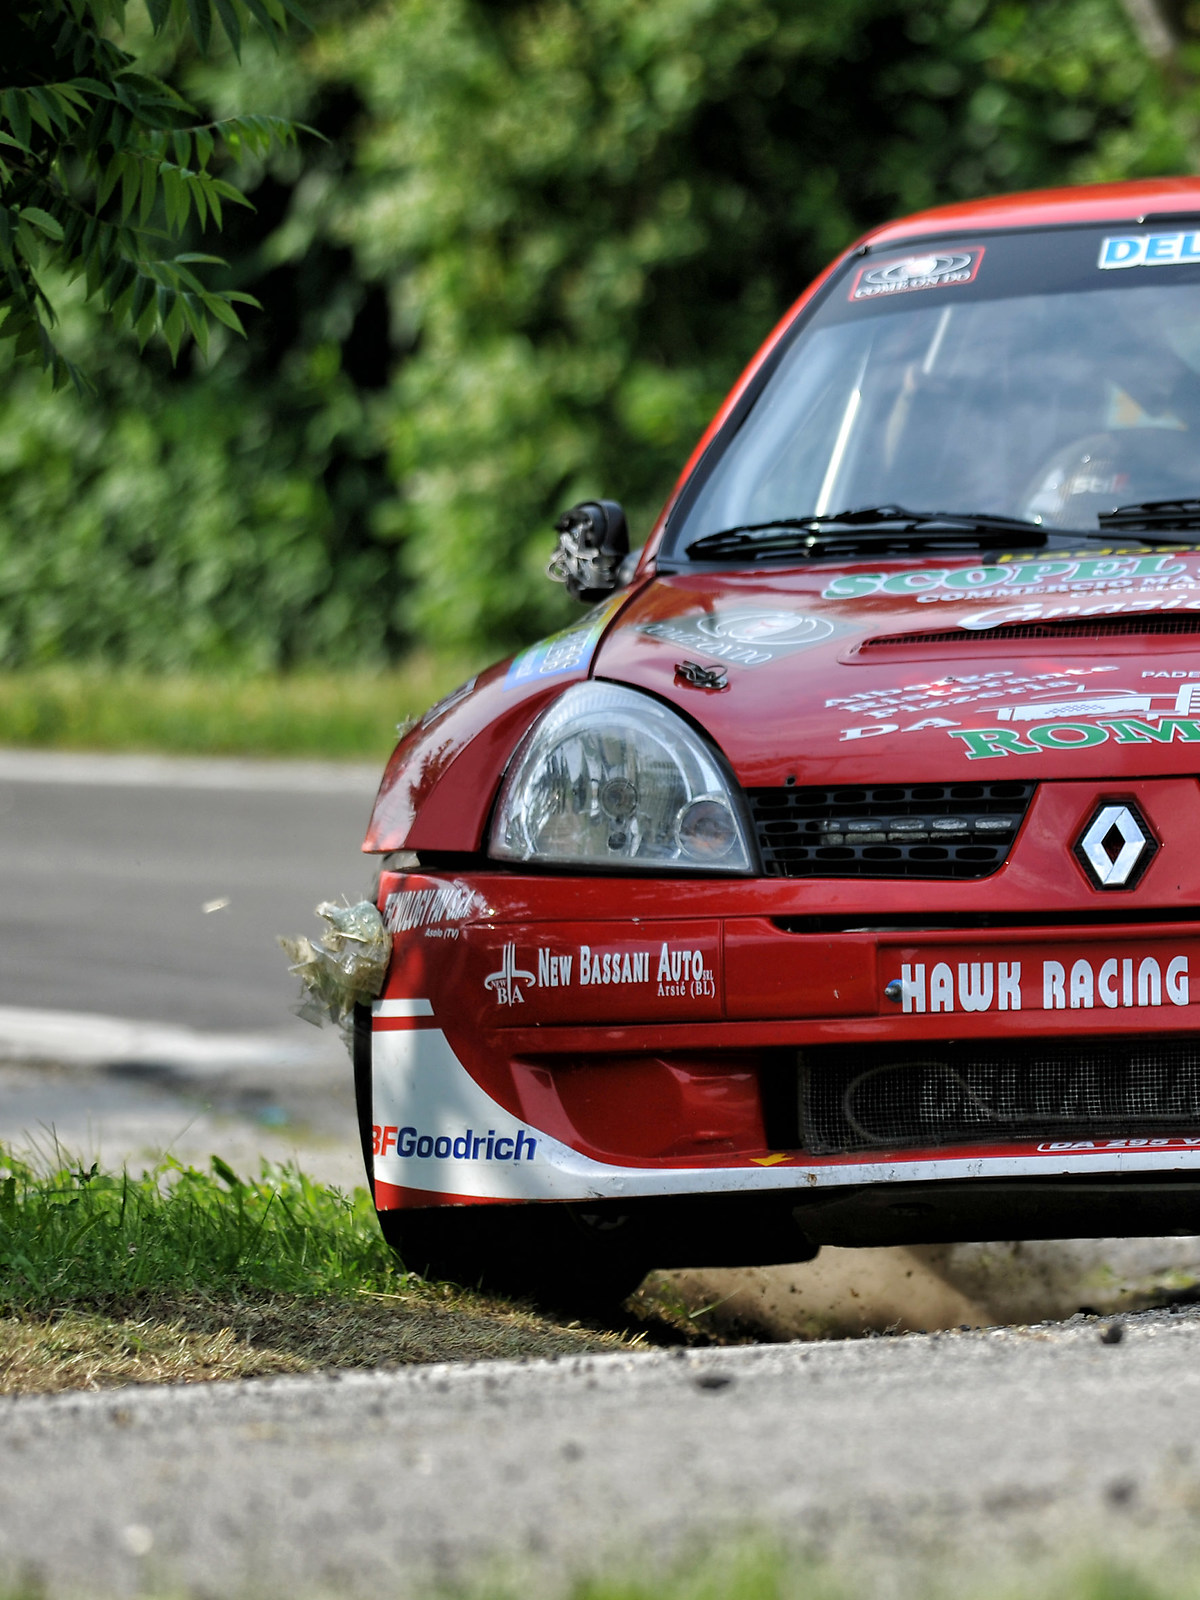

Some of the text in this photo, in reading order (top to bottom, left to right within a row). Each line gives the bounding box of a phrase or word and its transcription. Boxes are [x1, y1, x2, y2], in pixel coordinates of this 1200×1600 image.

[854, 270, 971, 299] COME ON DO
[822, 554, 1187, 600] SCOPEL
[916, 578, 1132, 603] COMMERCIO
[839, 717, 962, 742] DA
[424, 928, 460, 940] Asolo (TV)
[538, 947, 573, 988] NEW
[579, 945, 650, 985] BASSANI
[656, 942, 704, 982] AUTO
[656, 980, 716, 999] Arsié (BL)
[901, 961, 1021, 1013] HAWK
[1043, 955, 1189, 1009] RACING
[372, 1125, 538, 1161] BFGoodrich
[1049, 1140, 1095, 1150] DA
[1106, 1138, 1169, 1147] 295
